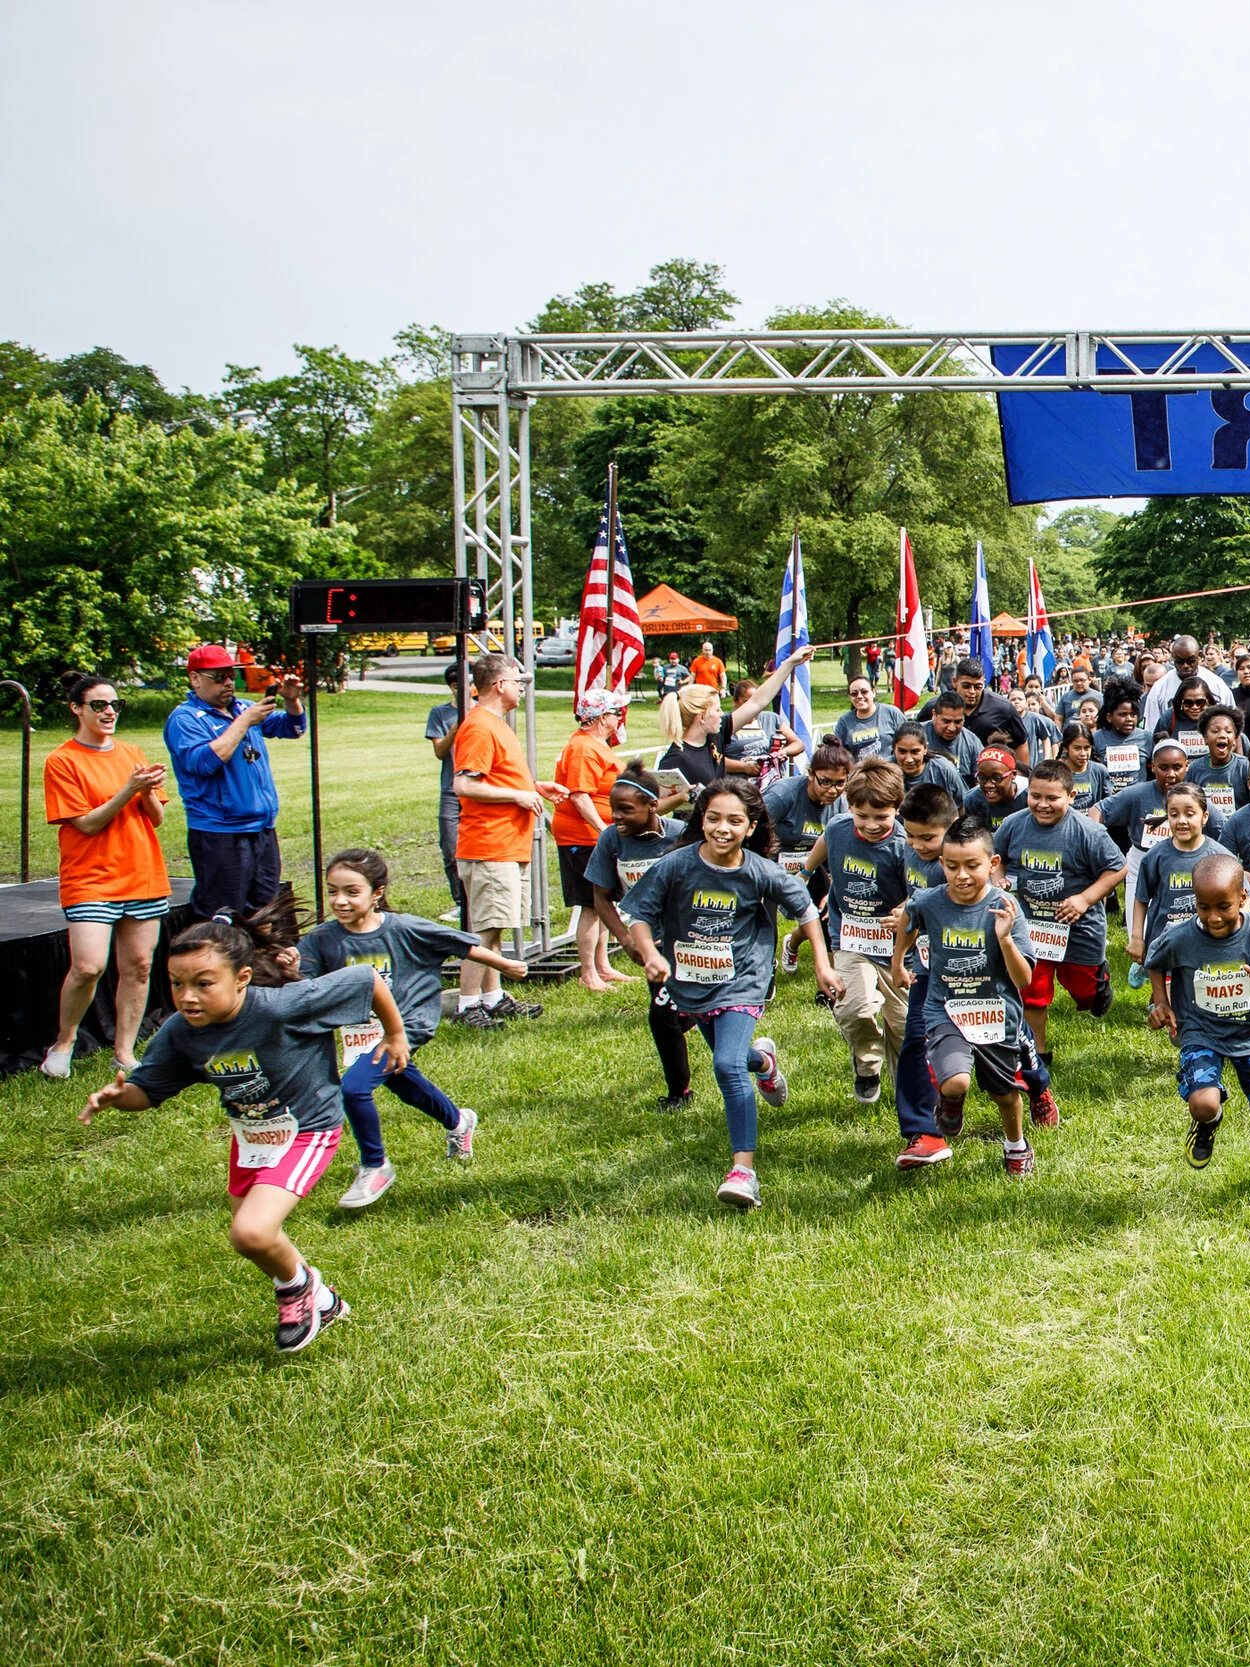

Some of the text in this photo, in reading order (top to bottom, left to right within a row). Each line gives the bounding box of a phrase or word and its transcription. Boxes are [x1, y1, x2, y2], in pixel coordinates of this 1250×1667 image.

[1181, 738, 1204, 746] BEIDLE
[1109, 752, 1138, 762] BEIDLER
[1210, 796, 1233, 804] IDLER
[1146, 825, 1173, 836] BEIDL
[846, 914, 874, 925] CHICAGO
[1028, 920, 1069, 932] CHICAGO RUN
[842, 924, 892, 941] CARDENAS
[1030, 930, 1068, 948] ARDENAS
[677, 943, 730, 952] CHICAGO RUN
[858, 944, 888, 955] Fun Run
[1035, 948, 1060, 959] Fun Run
[676, 952, 733, 970] CARDENAS
[696, 972, 729, 982] Fun Run
[1199, 972, 1233, 982] CHICAGO
[1206, 983, 1244, 998] MAYS
[949, 1000, 983, 1008] CHICAGO
[1215, 1001, 1249, 1012] Fun Run
[951, 1010, 1004, 1027] CARDENAS
